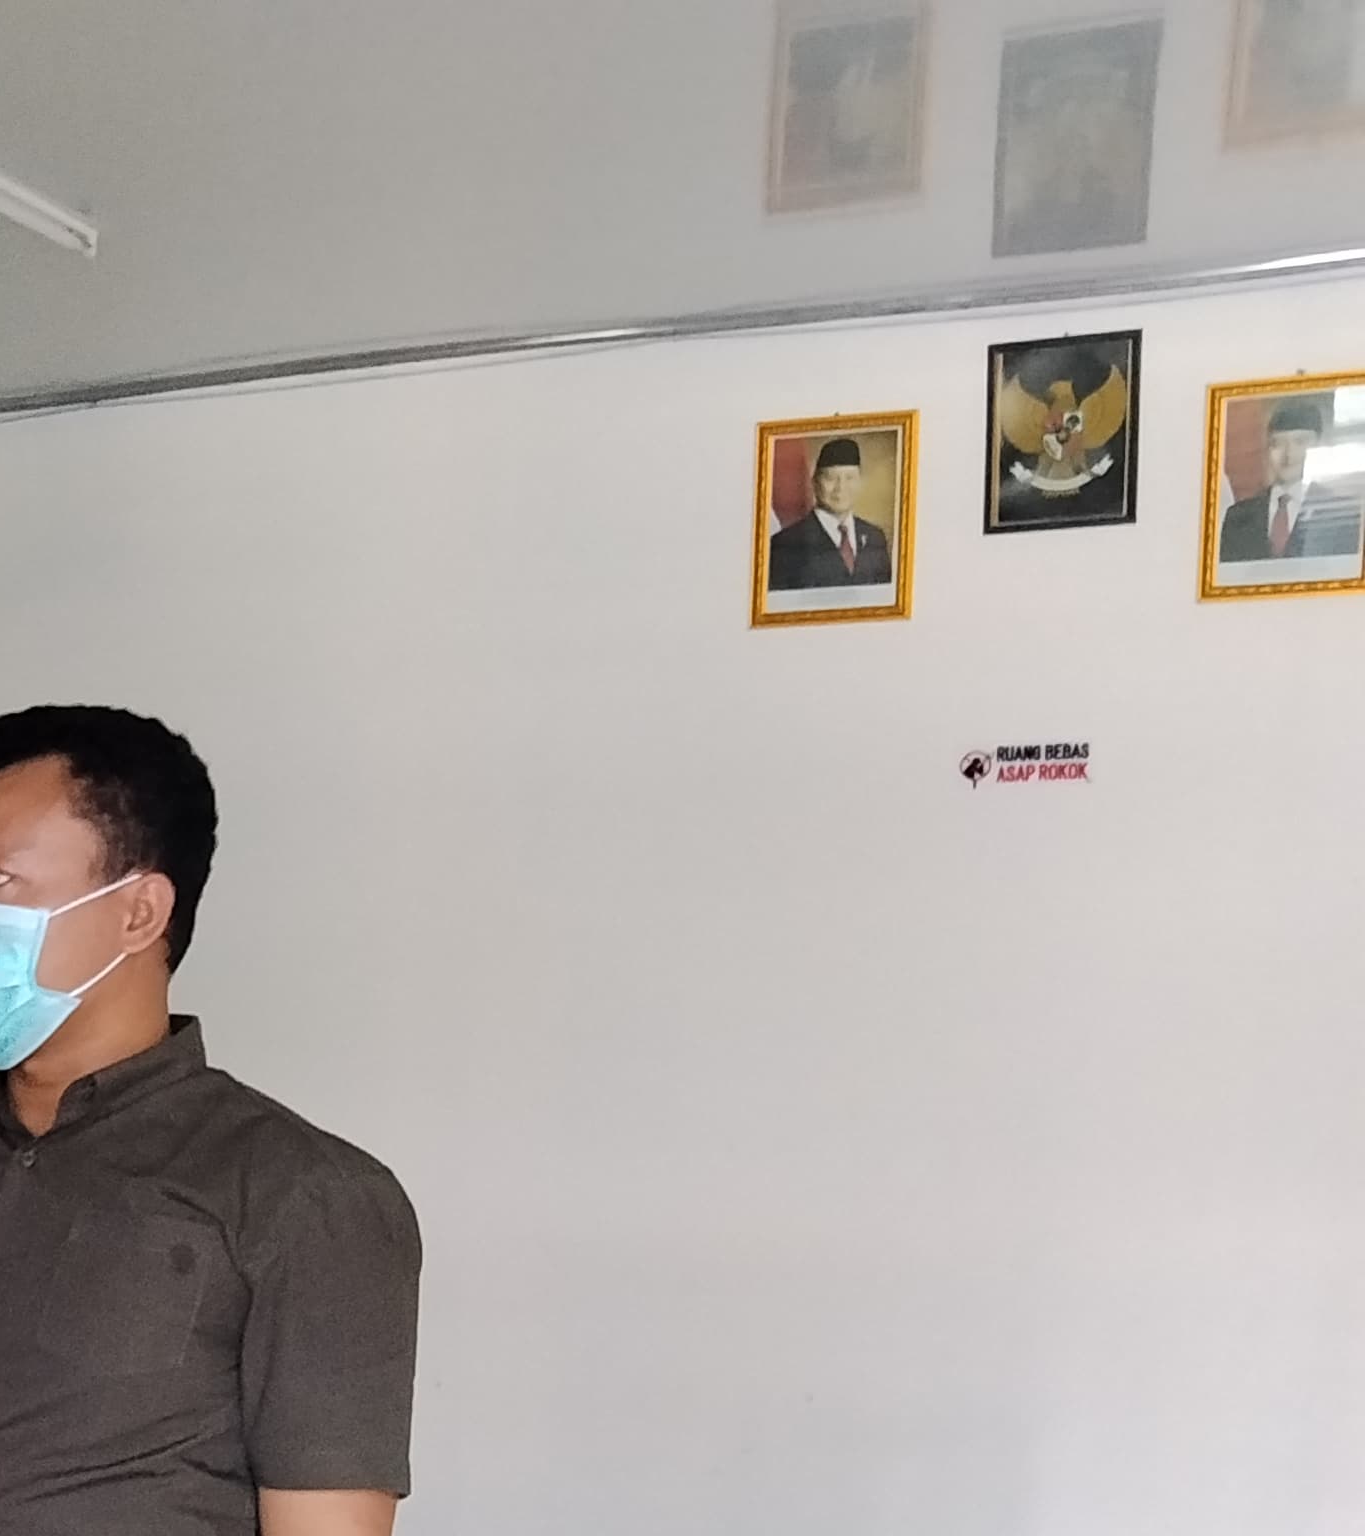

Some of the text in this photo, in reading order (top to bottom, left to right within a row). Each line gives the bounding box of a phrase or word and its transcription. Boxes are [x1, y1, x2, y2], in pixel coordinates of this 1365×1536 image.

[997, 743, 1089, 762] RUANG BEBAS
[997, 763, 1088, 782] ASAP ROKOK
